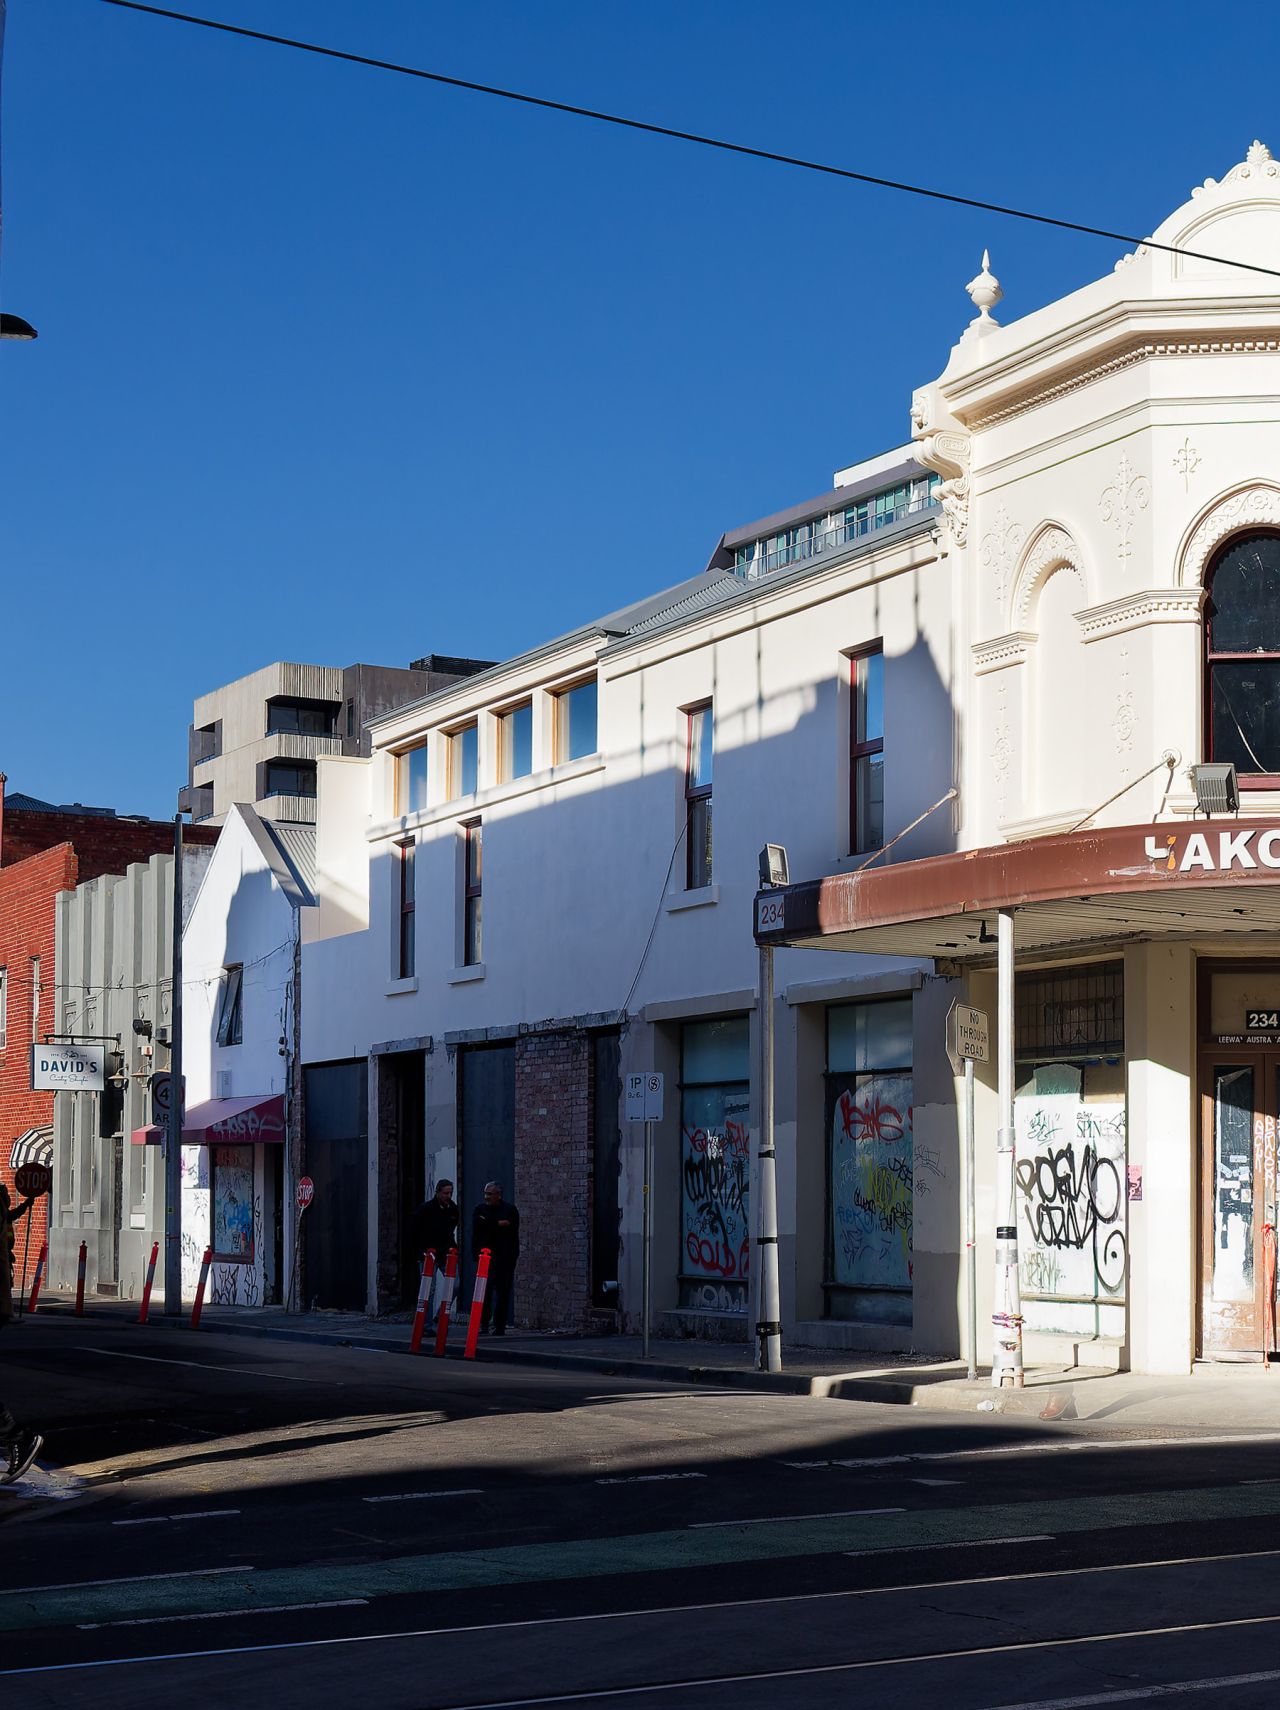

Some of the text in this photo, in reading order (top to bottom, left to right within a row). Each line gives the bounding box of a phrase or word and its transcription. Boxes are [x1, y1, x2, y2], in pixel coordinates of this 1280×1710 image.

[761, 902, 785, 925] 234
[969, 1010, 980, 1025] NO
[1248, 1013, 1279, 1028] 234
[964, 1042, 984, 1058] ROAD
[40, 1060, 98, 1073] DAVID'S
[630, 1077, 642, 1089] 1P
[17, 1171, 48, 1190] STOP
[297, 1184, 313, 1200] STOP
